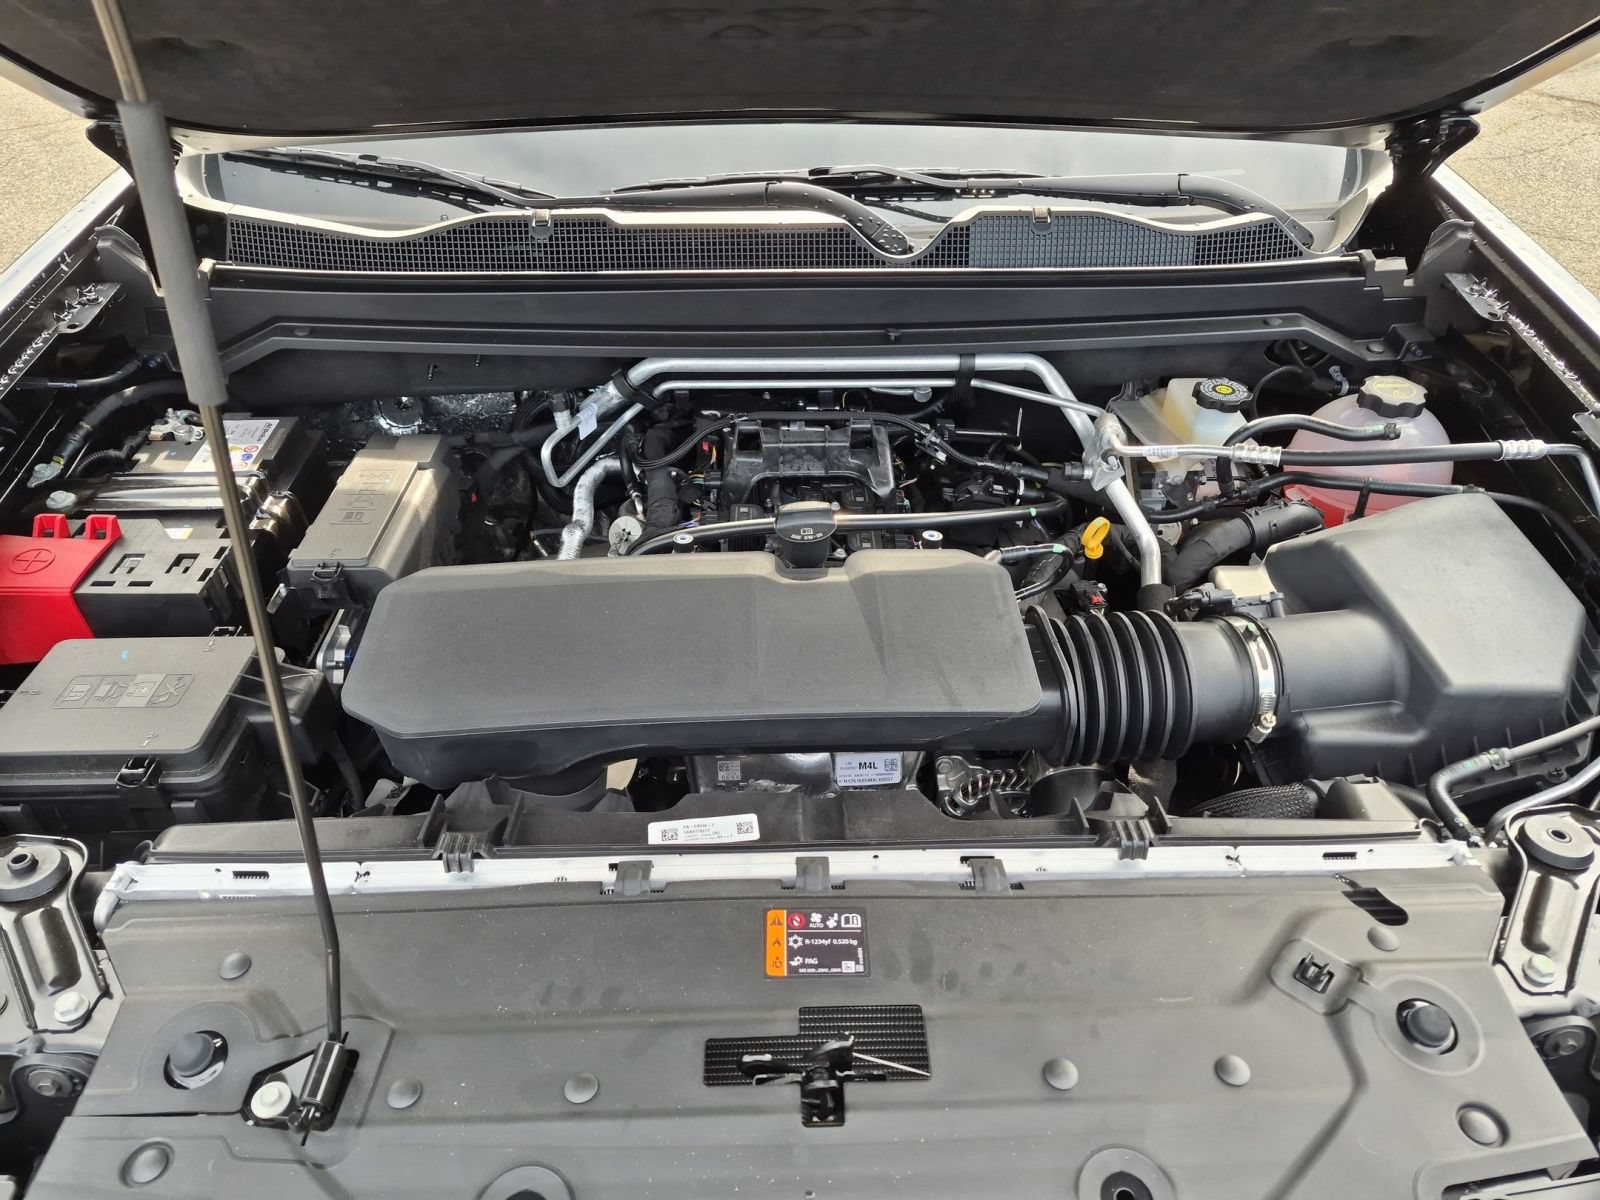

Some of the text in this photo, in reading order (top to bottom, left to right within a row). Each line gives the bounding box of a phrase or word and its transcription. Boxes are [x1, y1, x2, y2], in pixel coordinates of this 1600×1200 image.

[858, 761, 878, 770] M4L
[805, 938, 831, 946] R-1234yf
[849, 938, 858, 946] kg
